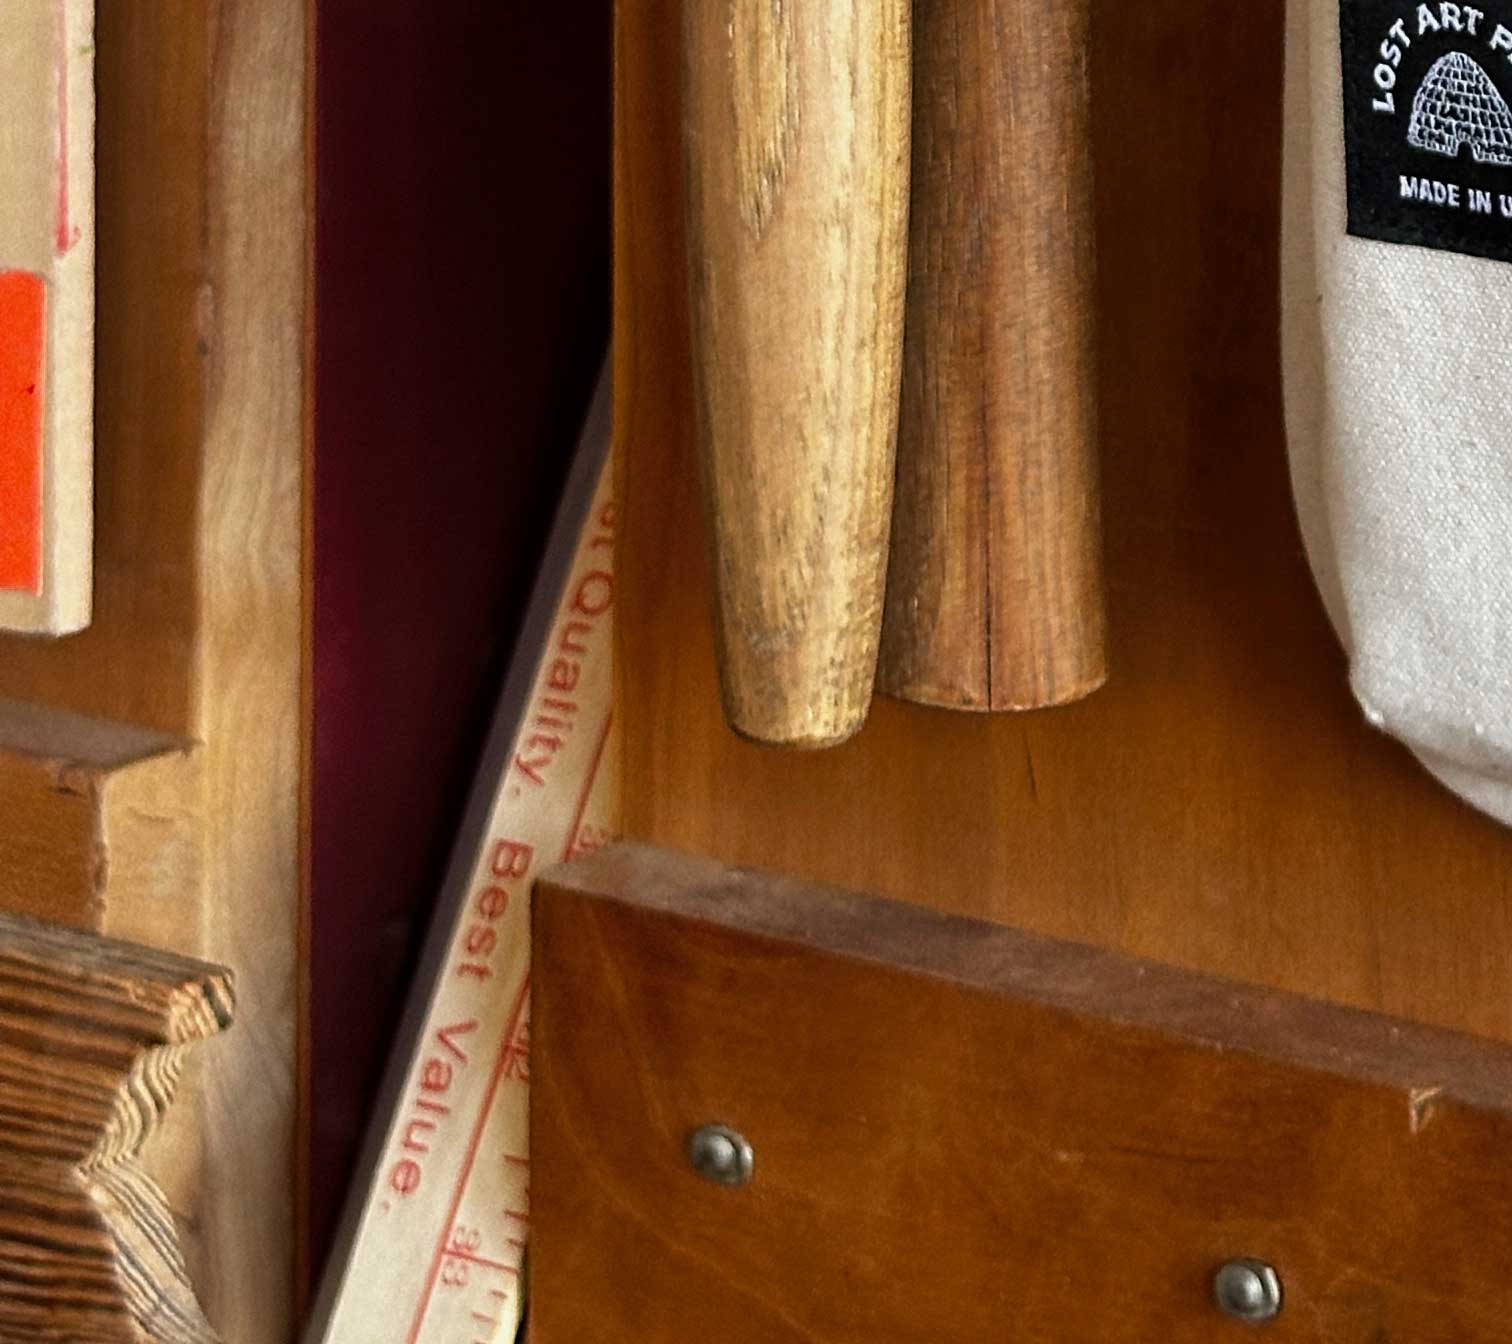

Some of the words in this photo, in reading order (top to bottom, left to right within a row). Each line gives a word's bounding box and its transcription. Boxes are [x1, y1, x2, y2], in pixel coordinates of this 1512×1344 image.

[1372, 17, 1412, 115] LOST
[1415, 1, 1485, 36] ART
[1399, 174, 1460, 208] MADE
[1467, 187, 1492, 214] IN
[512, 569, 615, 798] Quality.
[457, 837, 534, 980] Best
[380, 1019, 480, 1212] Value.
